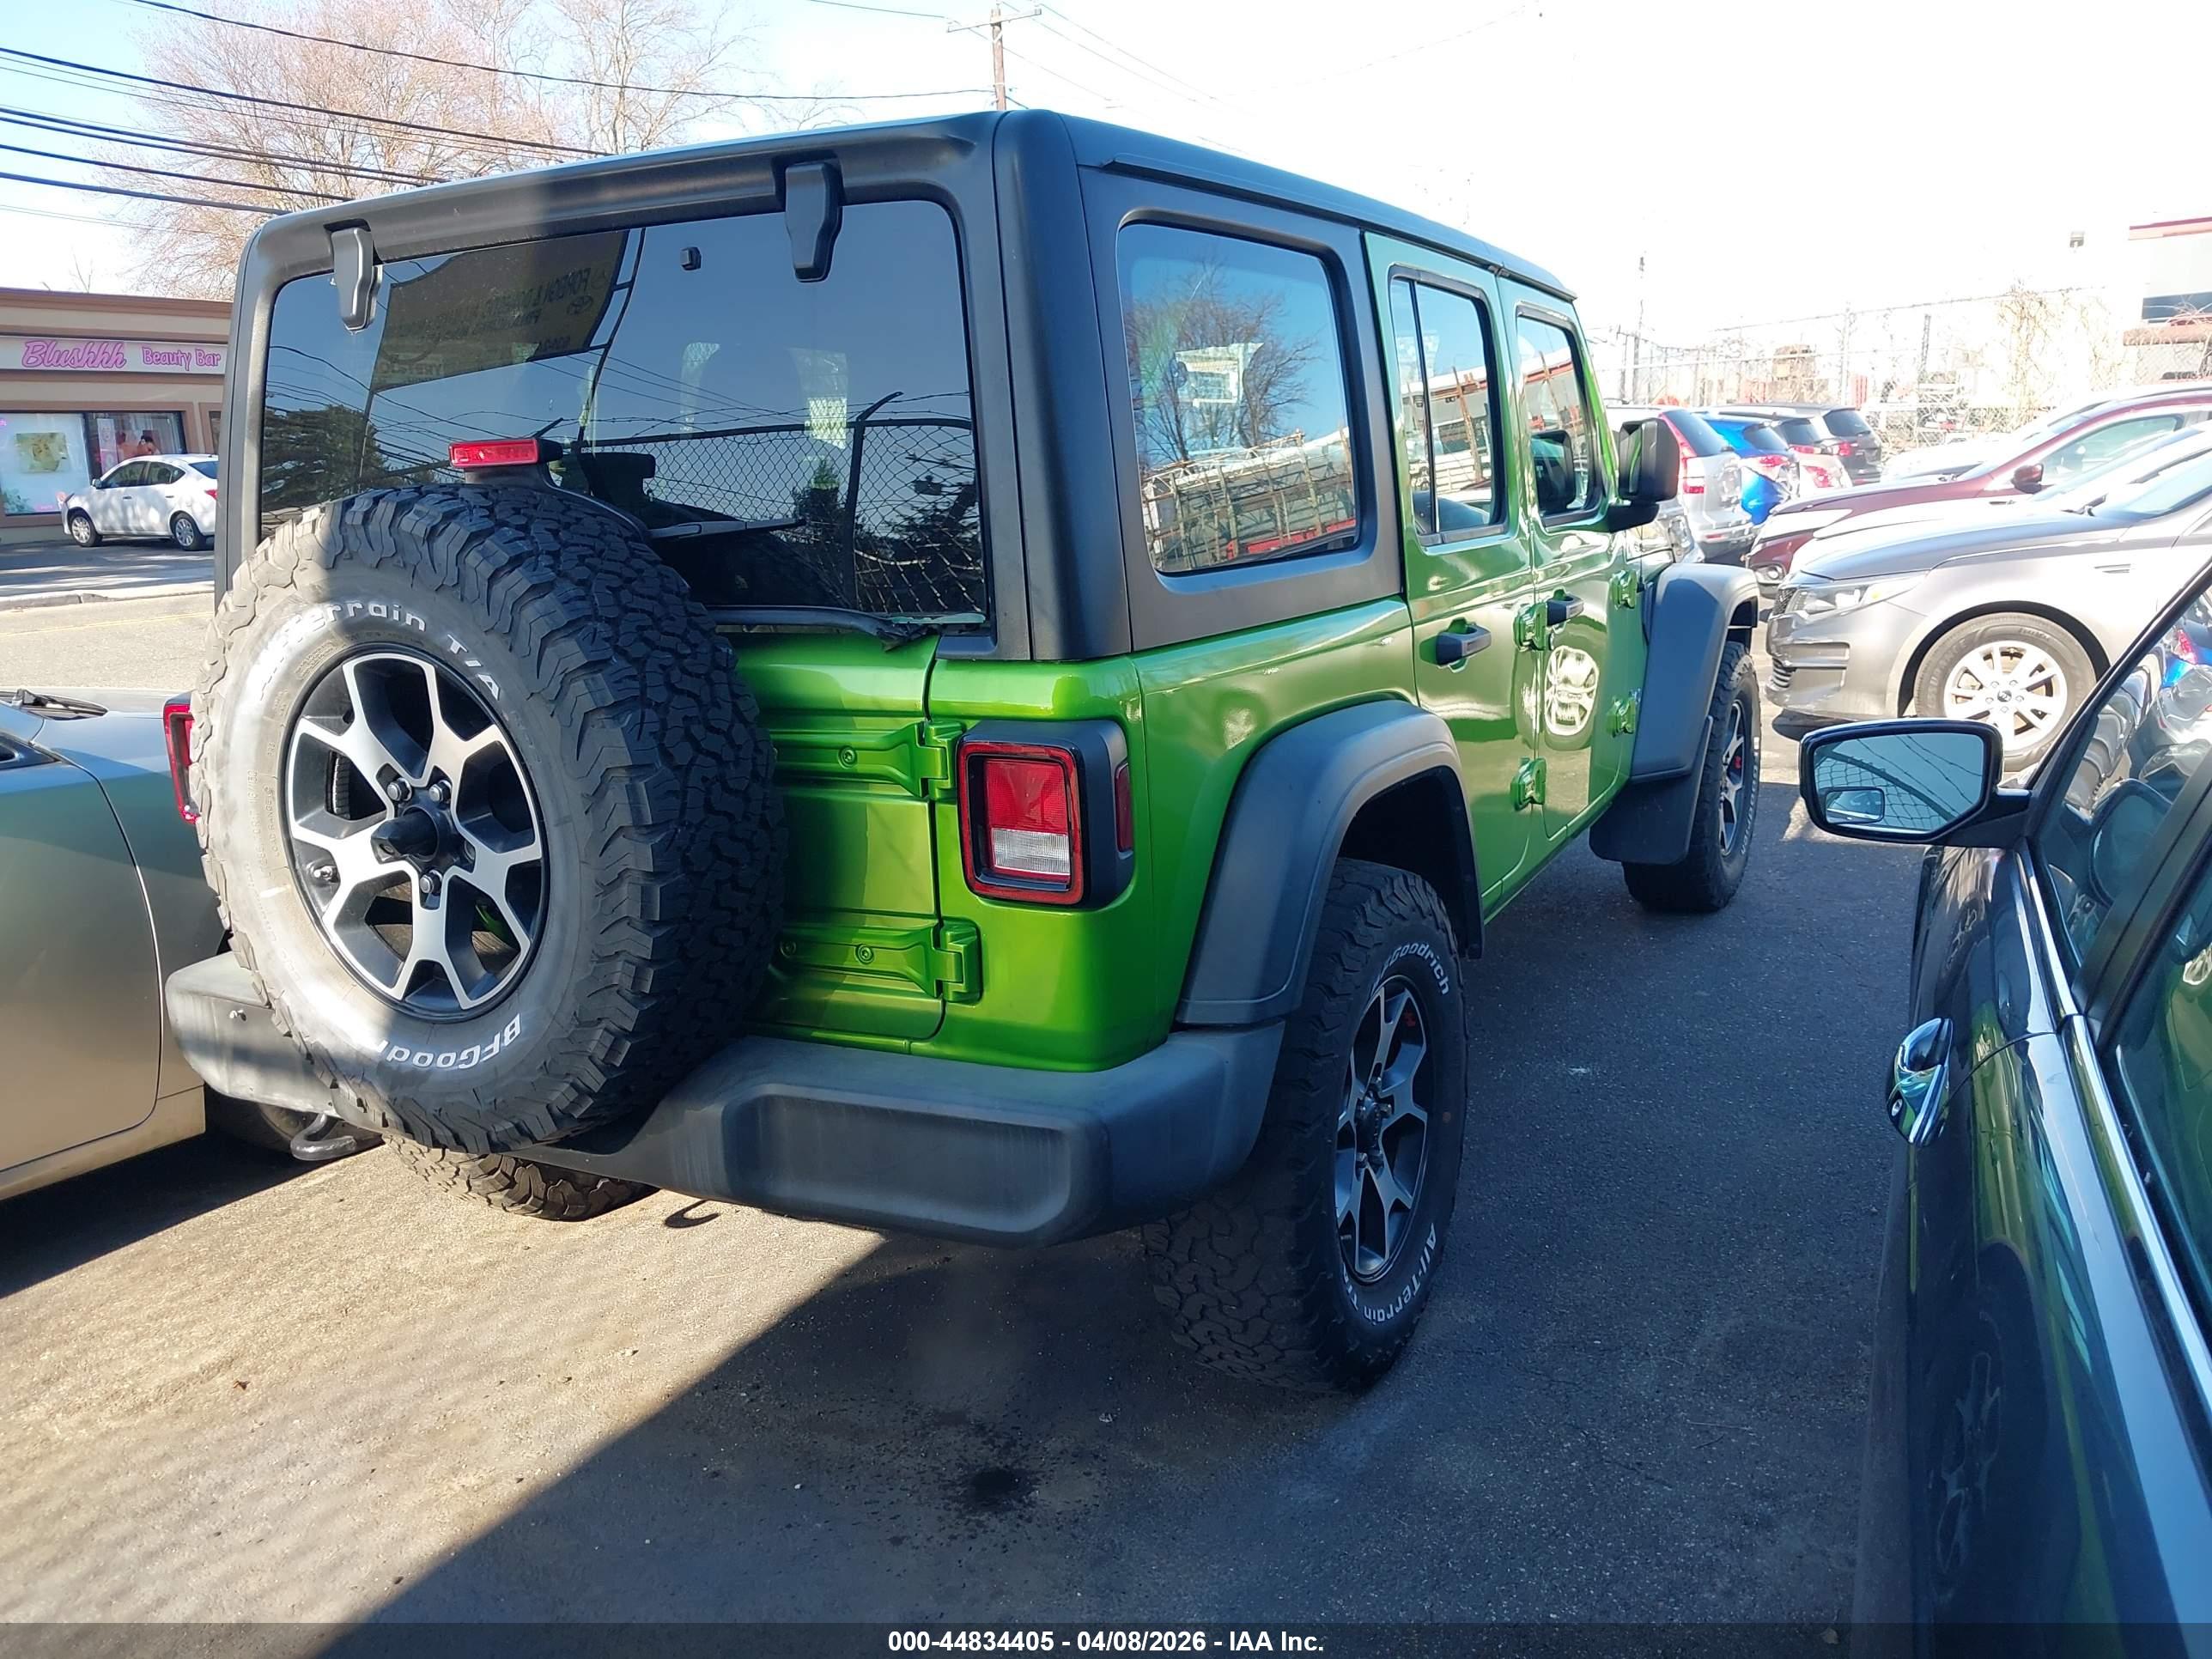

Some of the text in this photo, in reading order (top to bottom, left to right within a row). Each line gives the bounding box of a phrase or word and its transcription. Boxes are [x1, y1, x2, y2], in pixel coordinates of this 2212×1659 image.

[21, 340, 222, 371] Blushhh Beauty Bar
